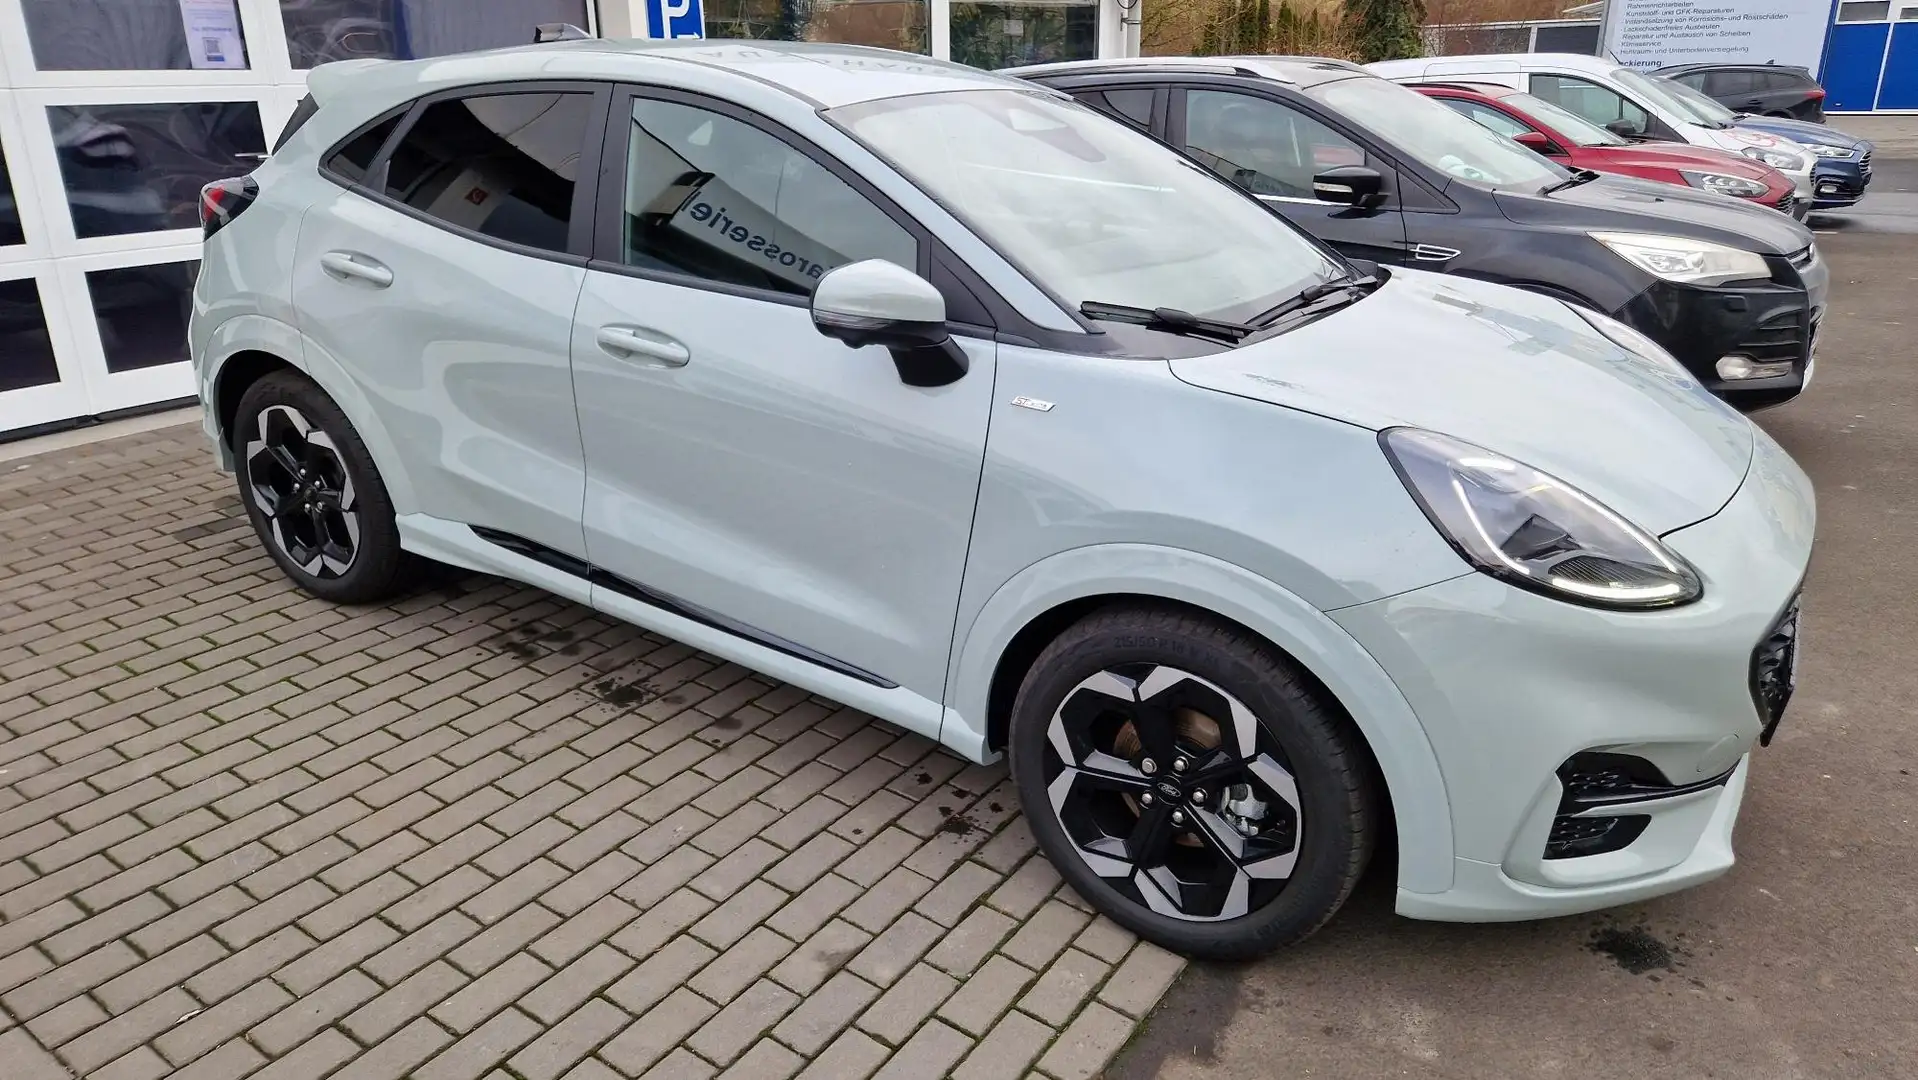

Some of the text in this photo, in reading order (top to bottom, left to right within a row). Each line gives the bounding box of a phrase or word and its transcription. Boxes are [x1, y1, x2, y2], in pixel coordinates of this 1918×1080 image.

[1627, 2, 1694, 10] Rahmenrichtarbeiten
[661, 0, 691, 39] P
[1622, 32, 1654, 40] Reparatur
